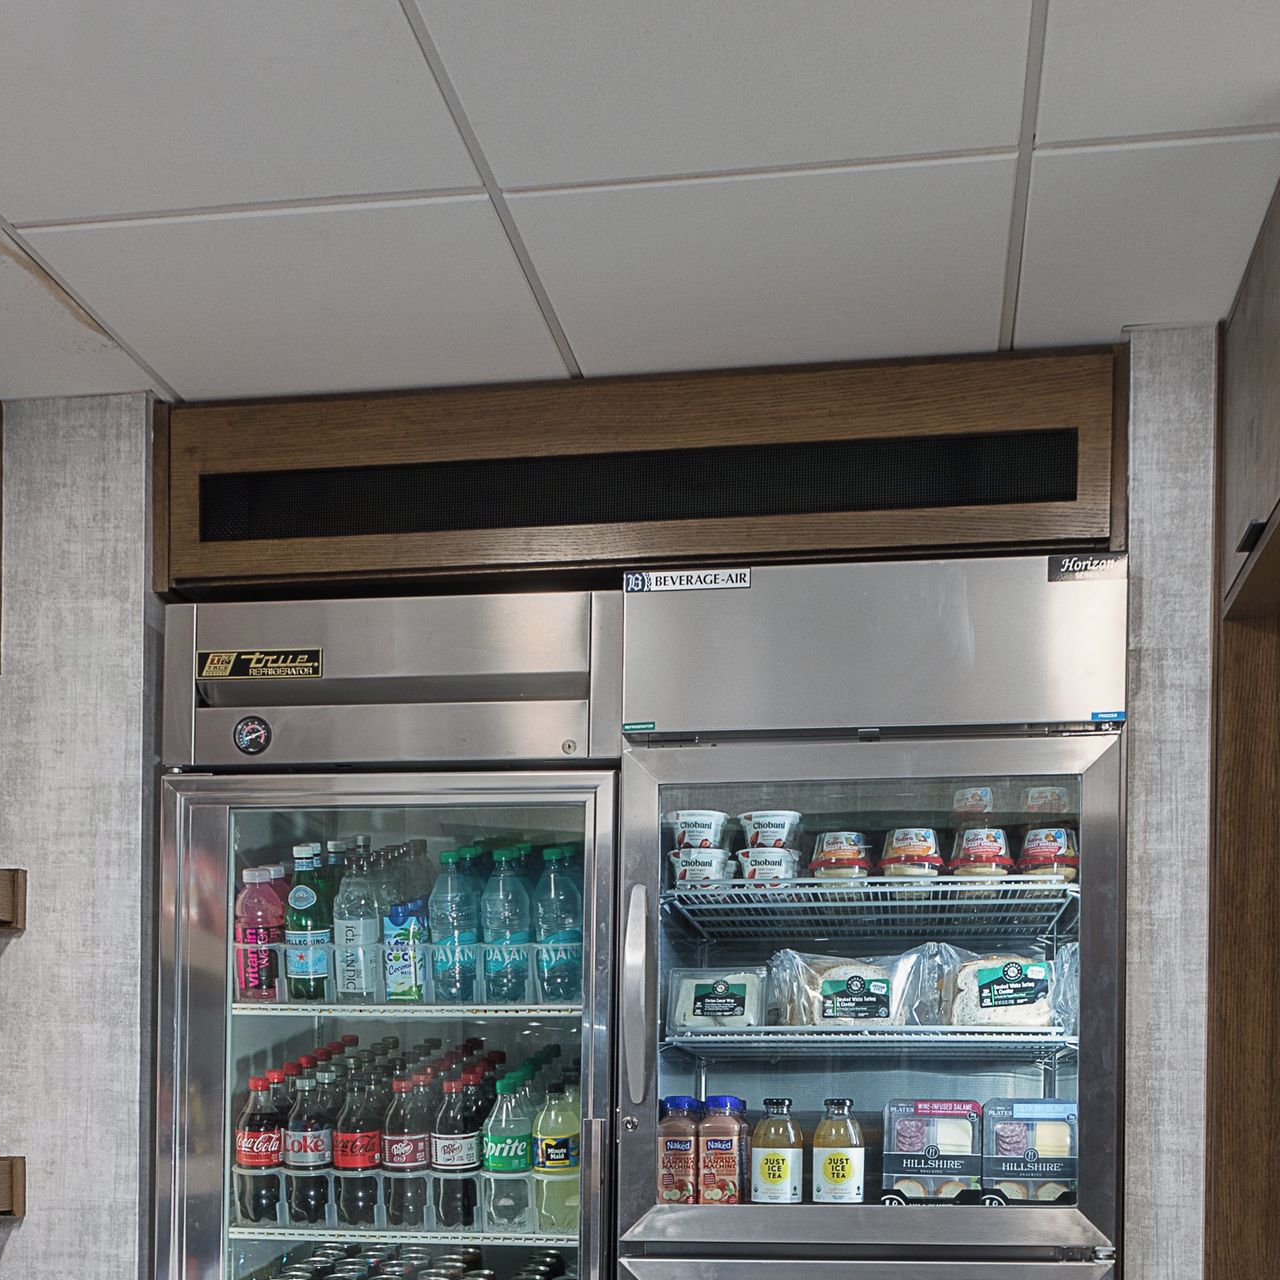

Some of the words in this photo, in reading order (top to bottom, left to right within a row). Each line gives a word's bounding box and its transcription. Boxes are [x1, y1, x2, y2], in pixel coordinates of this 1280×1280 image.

[1060, 556, 1116, 572] Horizon
[654, 572, 748, 587] BEVERAGE-AIR
[249, 667, 313, 677] REFRIGERATOR
[679, 821, 713, 830] Chobani
[752, 821, 786, 830] Chobani
[680, 859, 713, 868] Chobani
[749, 859, 783, 867] Chobani
[482, 1137, 527, 1159] Sprite
[666, 1141, 692, 1151] Naked
[706, 1141, 732, 1150] Naked
[764, 1157, 787, 1166] JUST
[827, 1157, 851, 1166] JUST
[902, 1158, 962, 1169] HILLSHIRE
[1001, 1161, 1062, 1172] HILLSHIRE
[767, 1172, 783, 1180] TEA
[831, 1172, 847, 1180] TEA
